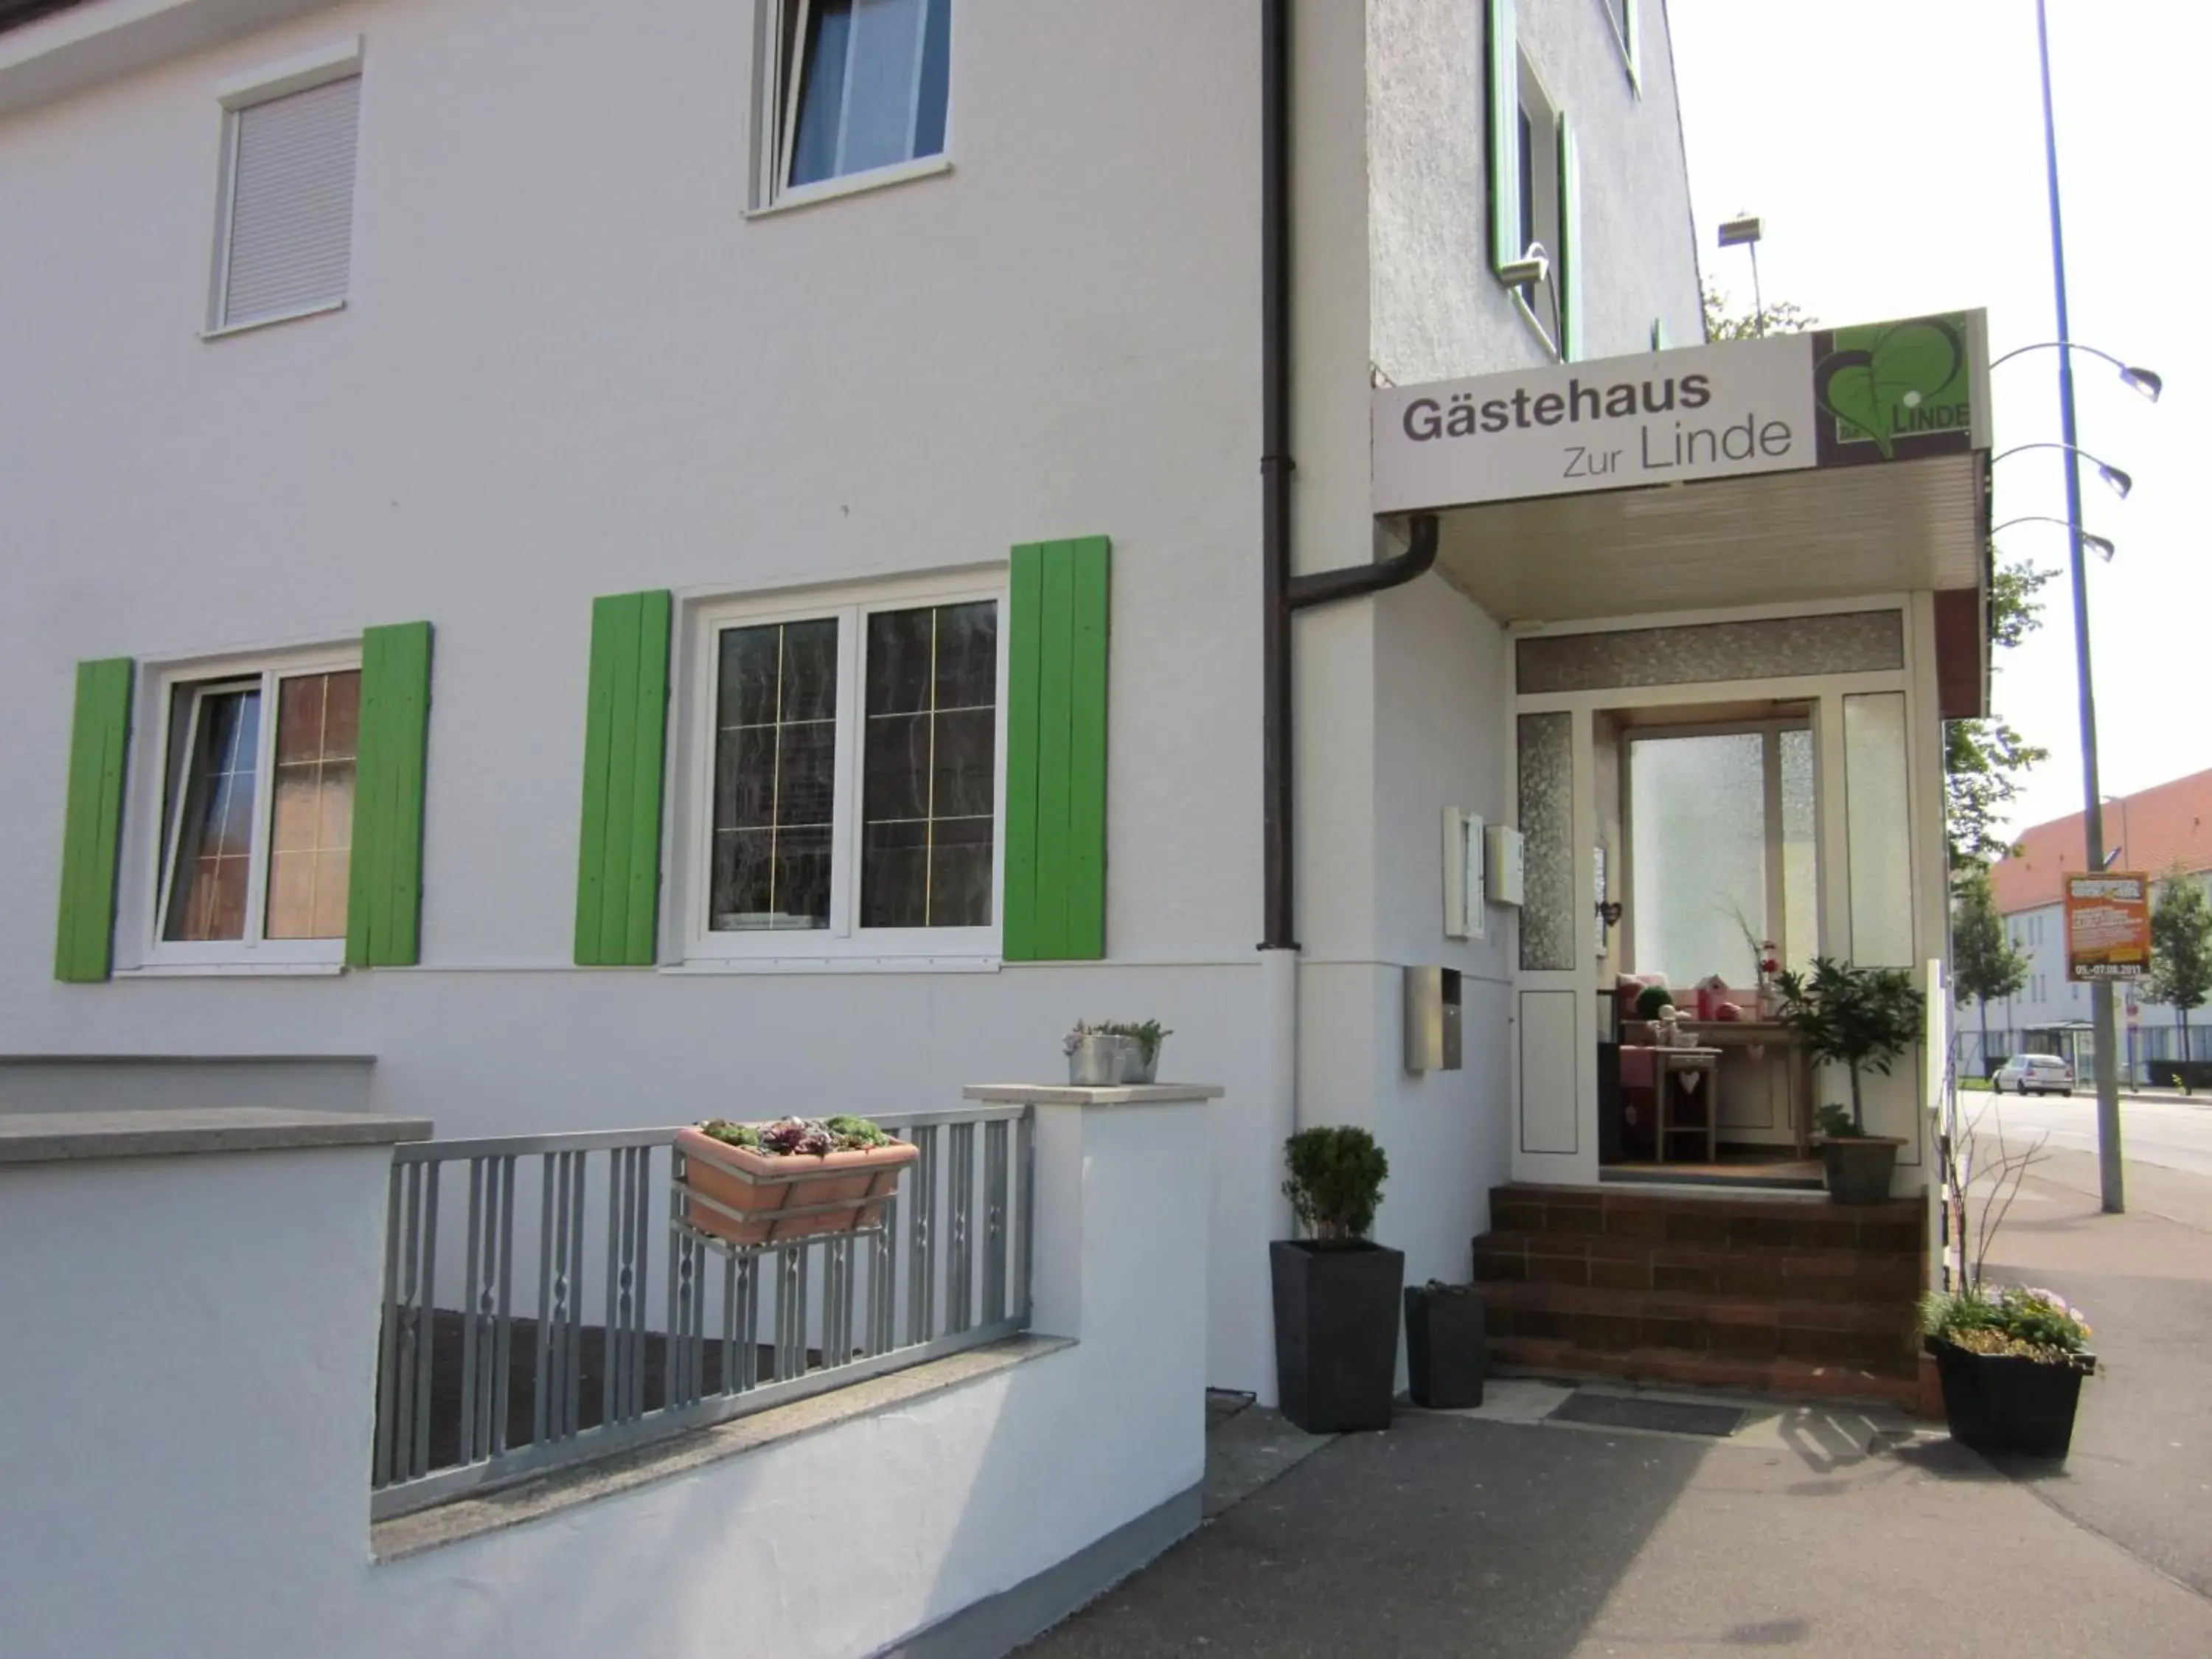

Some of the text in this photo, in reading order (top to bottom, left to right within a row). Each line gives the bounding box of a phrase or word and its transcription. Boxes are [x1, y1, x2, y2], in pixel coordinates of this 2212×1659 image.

[1403, 374, 1711, 442] Gästehaus
[1893, 404, 1969, 434] LINDE
[1563, 413, 1791, 477] Zur Linde
